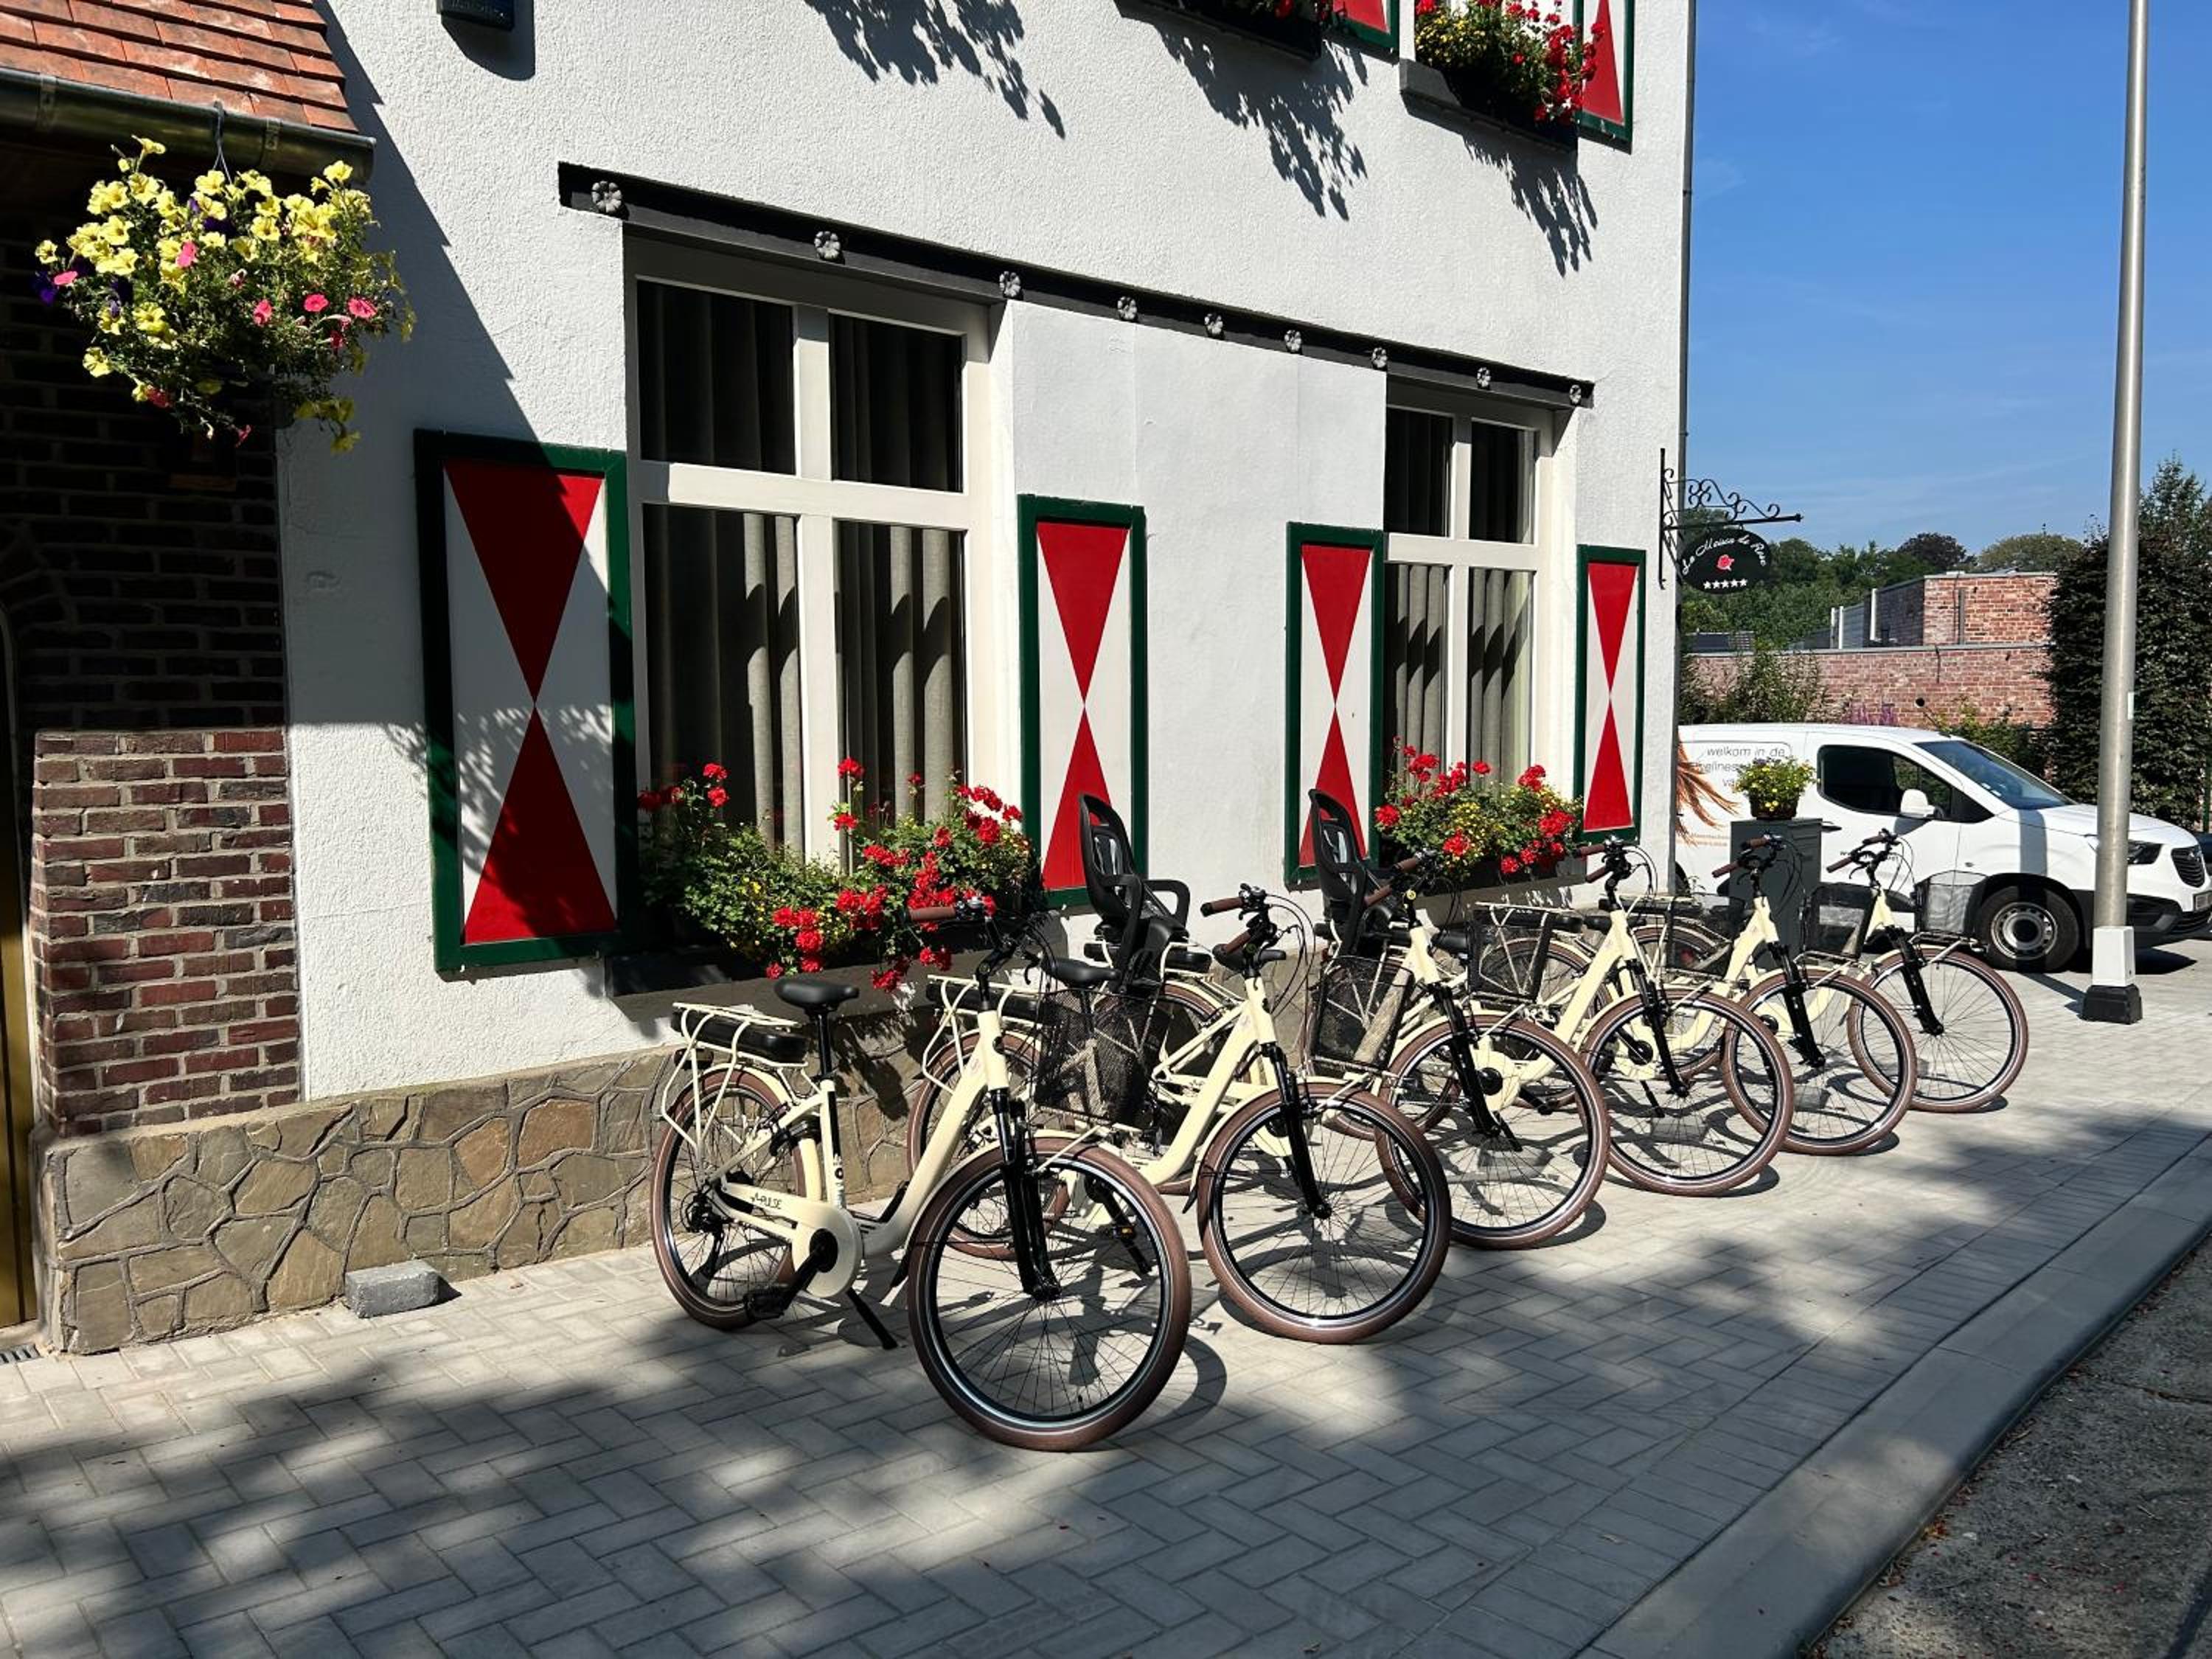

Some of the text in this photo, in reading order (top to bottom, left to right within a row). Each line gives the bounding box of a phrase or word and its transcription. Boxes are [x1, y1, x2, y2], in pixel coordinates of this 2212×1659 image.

[1707, 746, 1785, 757] welkom in de
